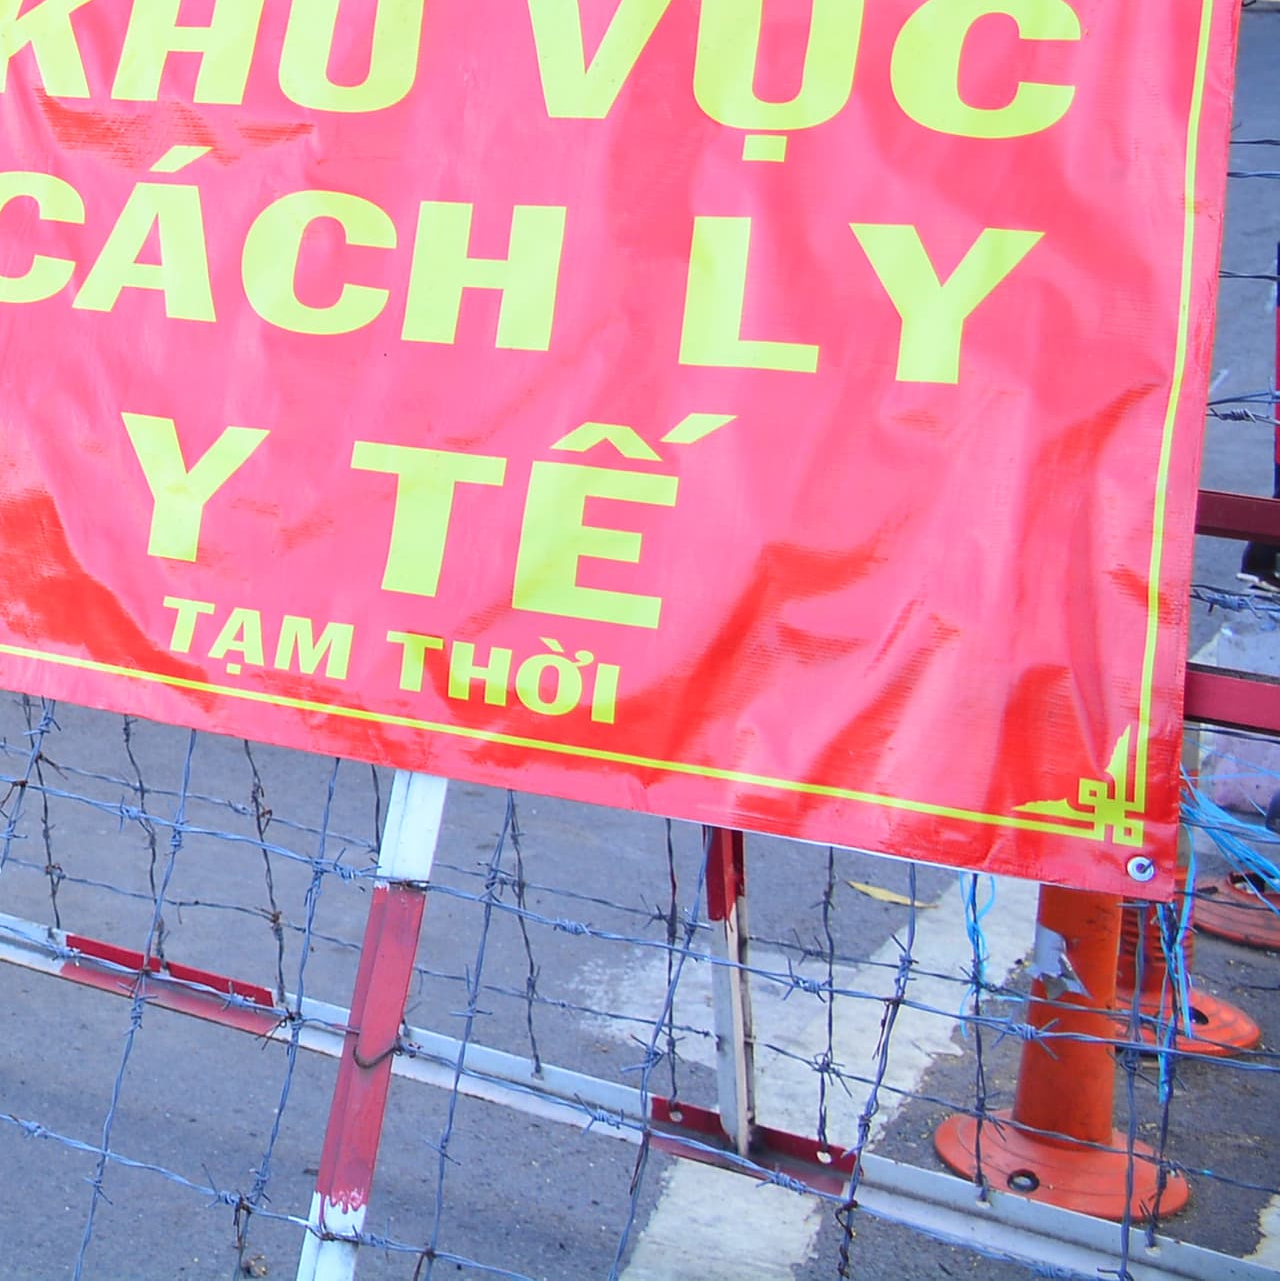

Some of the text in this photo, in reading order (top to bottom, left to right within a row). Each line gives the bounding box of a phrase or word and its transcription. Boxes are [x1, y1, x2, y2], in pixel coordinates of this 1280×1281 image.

[678, 216, 1046, 385] LY
[121, 411, 738, 630] Y TẾ
[162, 596, 620, 725] TẠM THỜI
